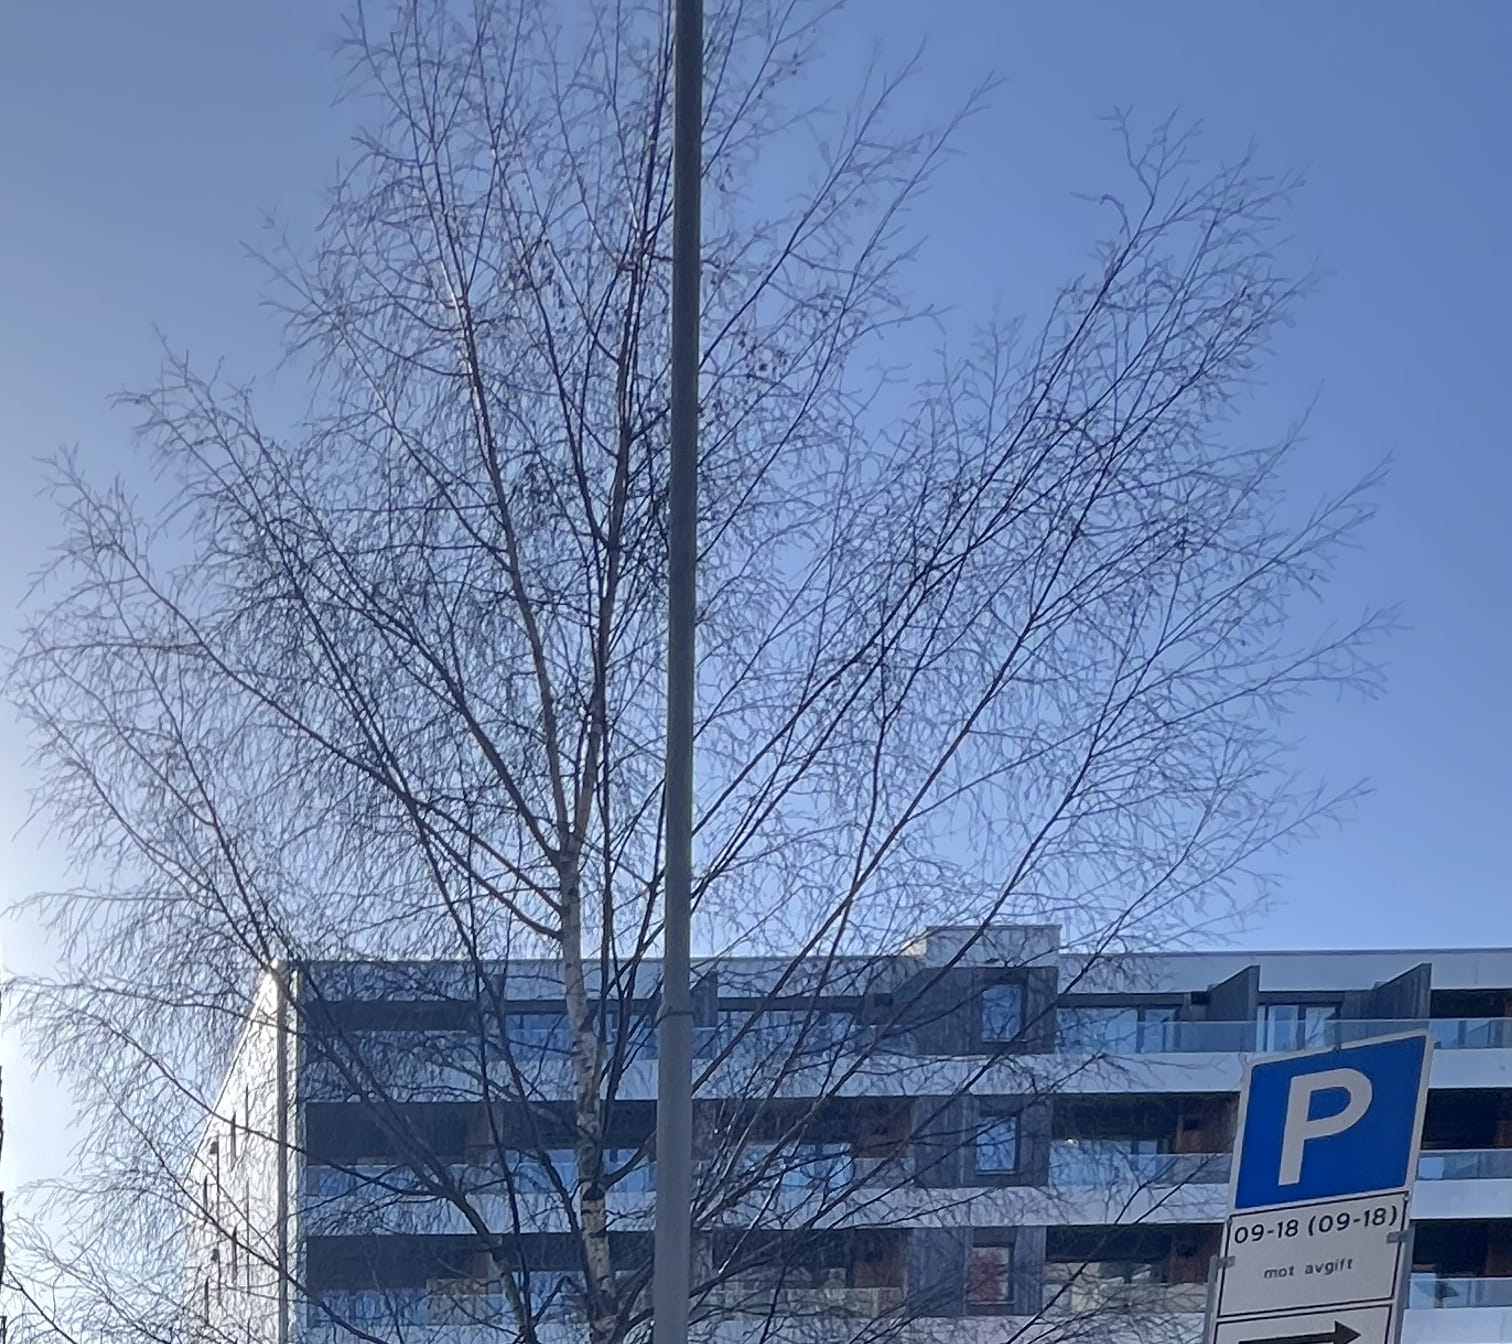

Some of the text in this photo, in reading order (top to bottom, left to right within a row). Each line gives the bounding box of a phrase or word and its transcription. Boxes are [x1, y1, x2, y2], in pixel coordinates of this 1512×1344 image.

[1278, 1068, 1372, 1186] P
[1235, 1205, 1398, 1244] 09-18 (09-18)
[1263, 1258, 1353, 1279] mot avgift
